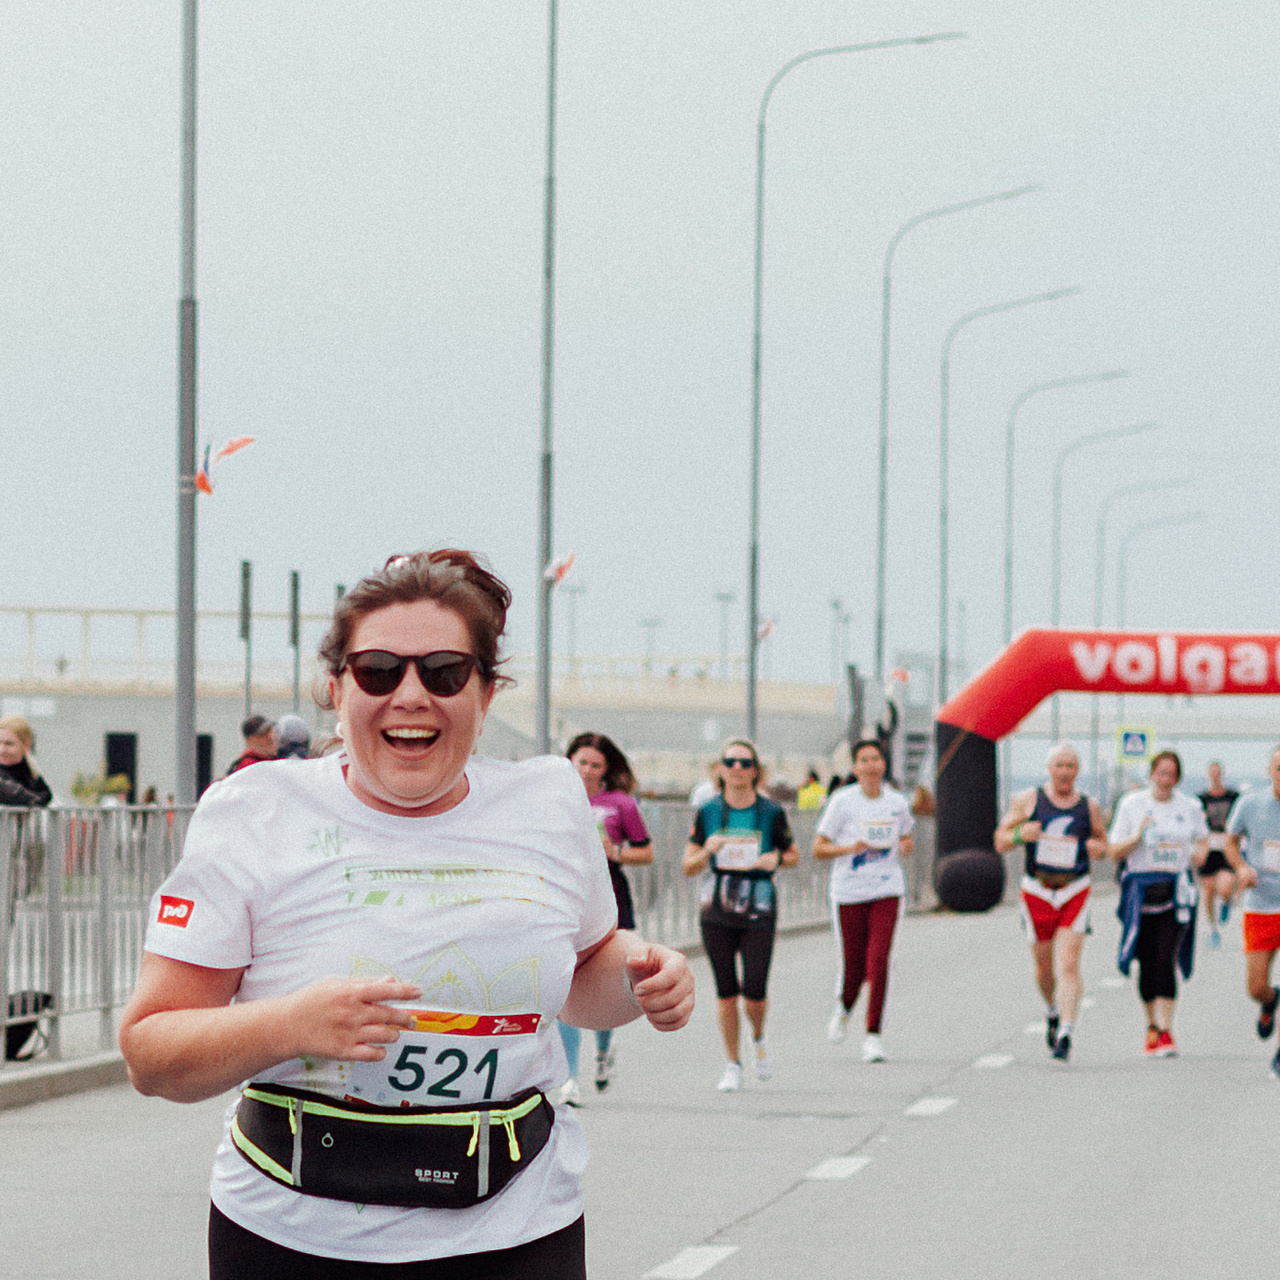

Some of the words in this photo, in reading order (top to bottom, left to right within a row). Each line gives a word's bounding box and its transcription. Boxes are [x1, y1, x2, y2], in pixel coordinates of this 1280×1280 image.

[1070, 634, 1280, 694] volga
[387, 1044, 499, 1100] 521
[414, 1168, 459, 1179] SPORT
